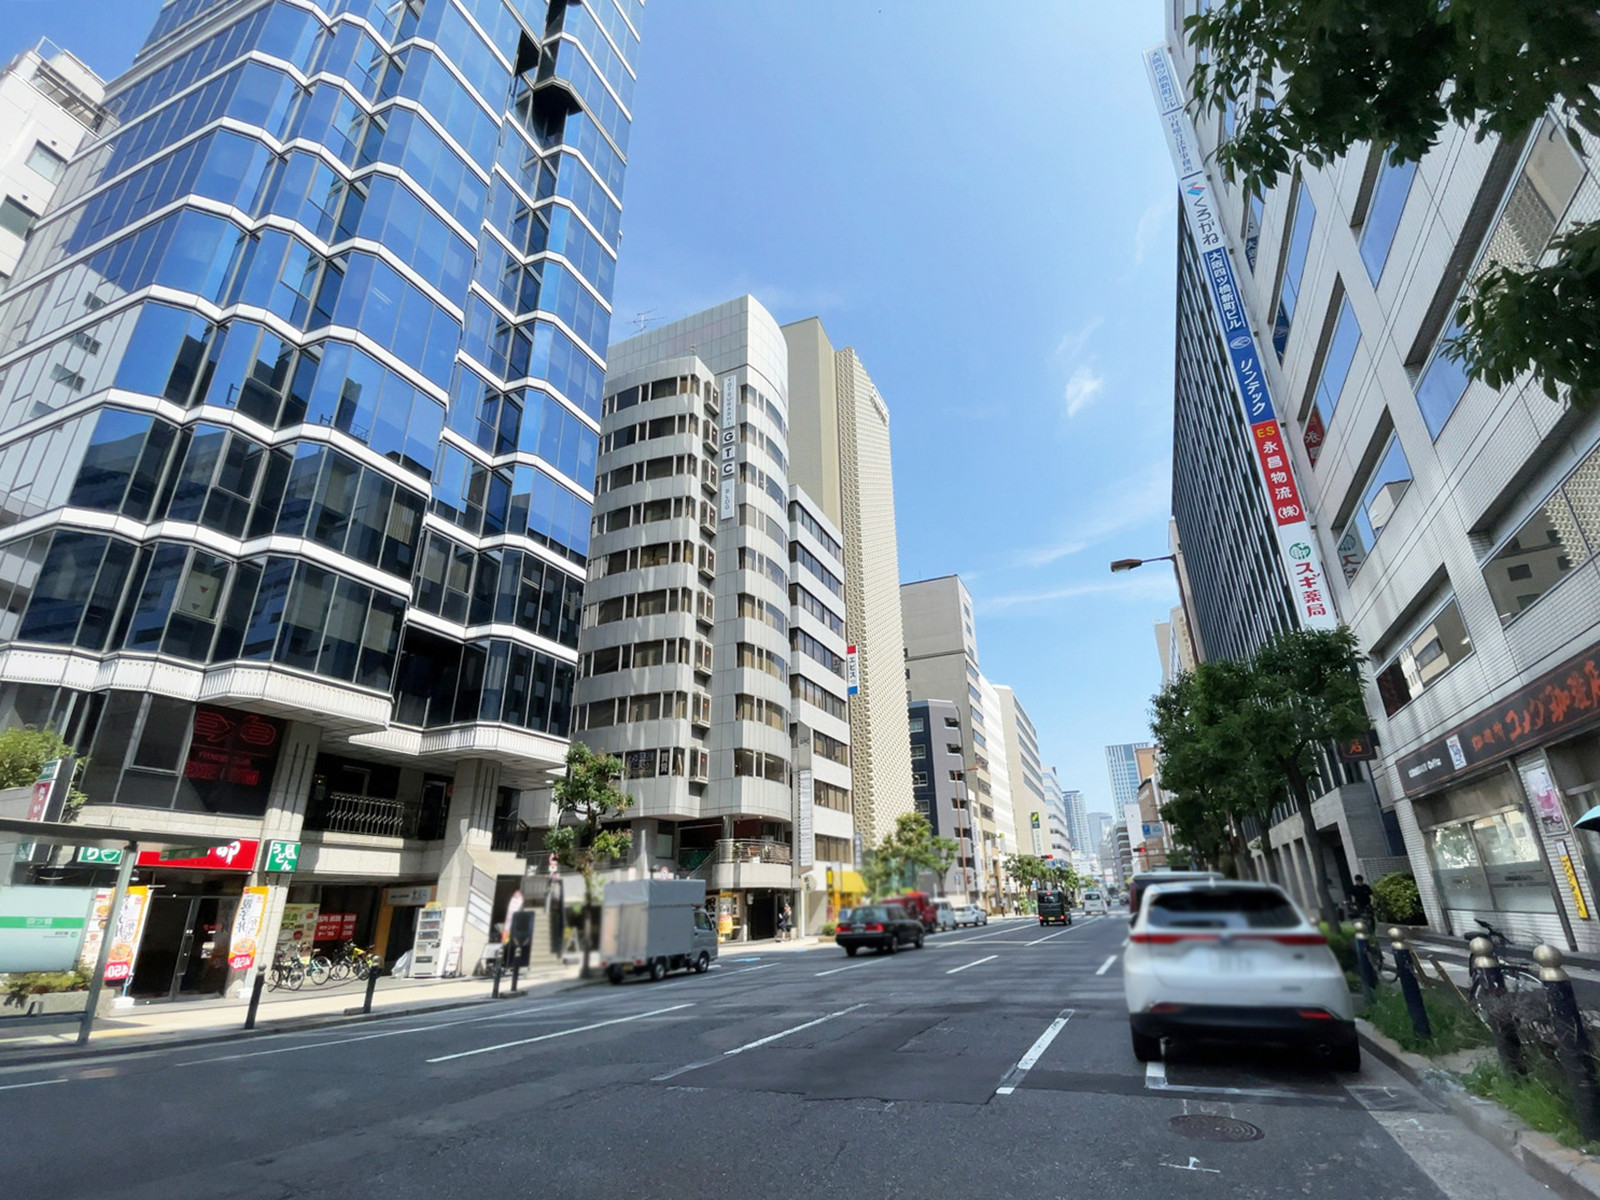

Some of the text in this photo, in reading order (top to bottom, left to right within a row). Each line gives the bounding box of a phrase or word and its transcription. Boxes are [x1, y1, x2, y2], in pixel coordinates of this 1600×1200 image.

[1193, 196, 1220, 246] くろがね
[1208, 251, 1243, 331] 大阪四ツ橋新町ビル
[1240, 357, 1266, 417] リンテック
[723, 432, 734, 474] GTC
[1256, 425, 1276, 439] ES
[1295, 561, 1327, 618] スギ薬局
